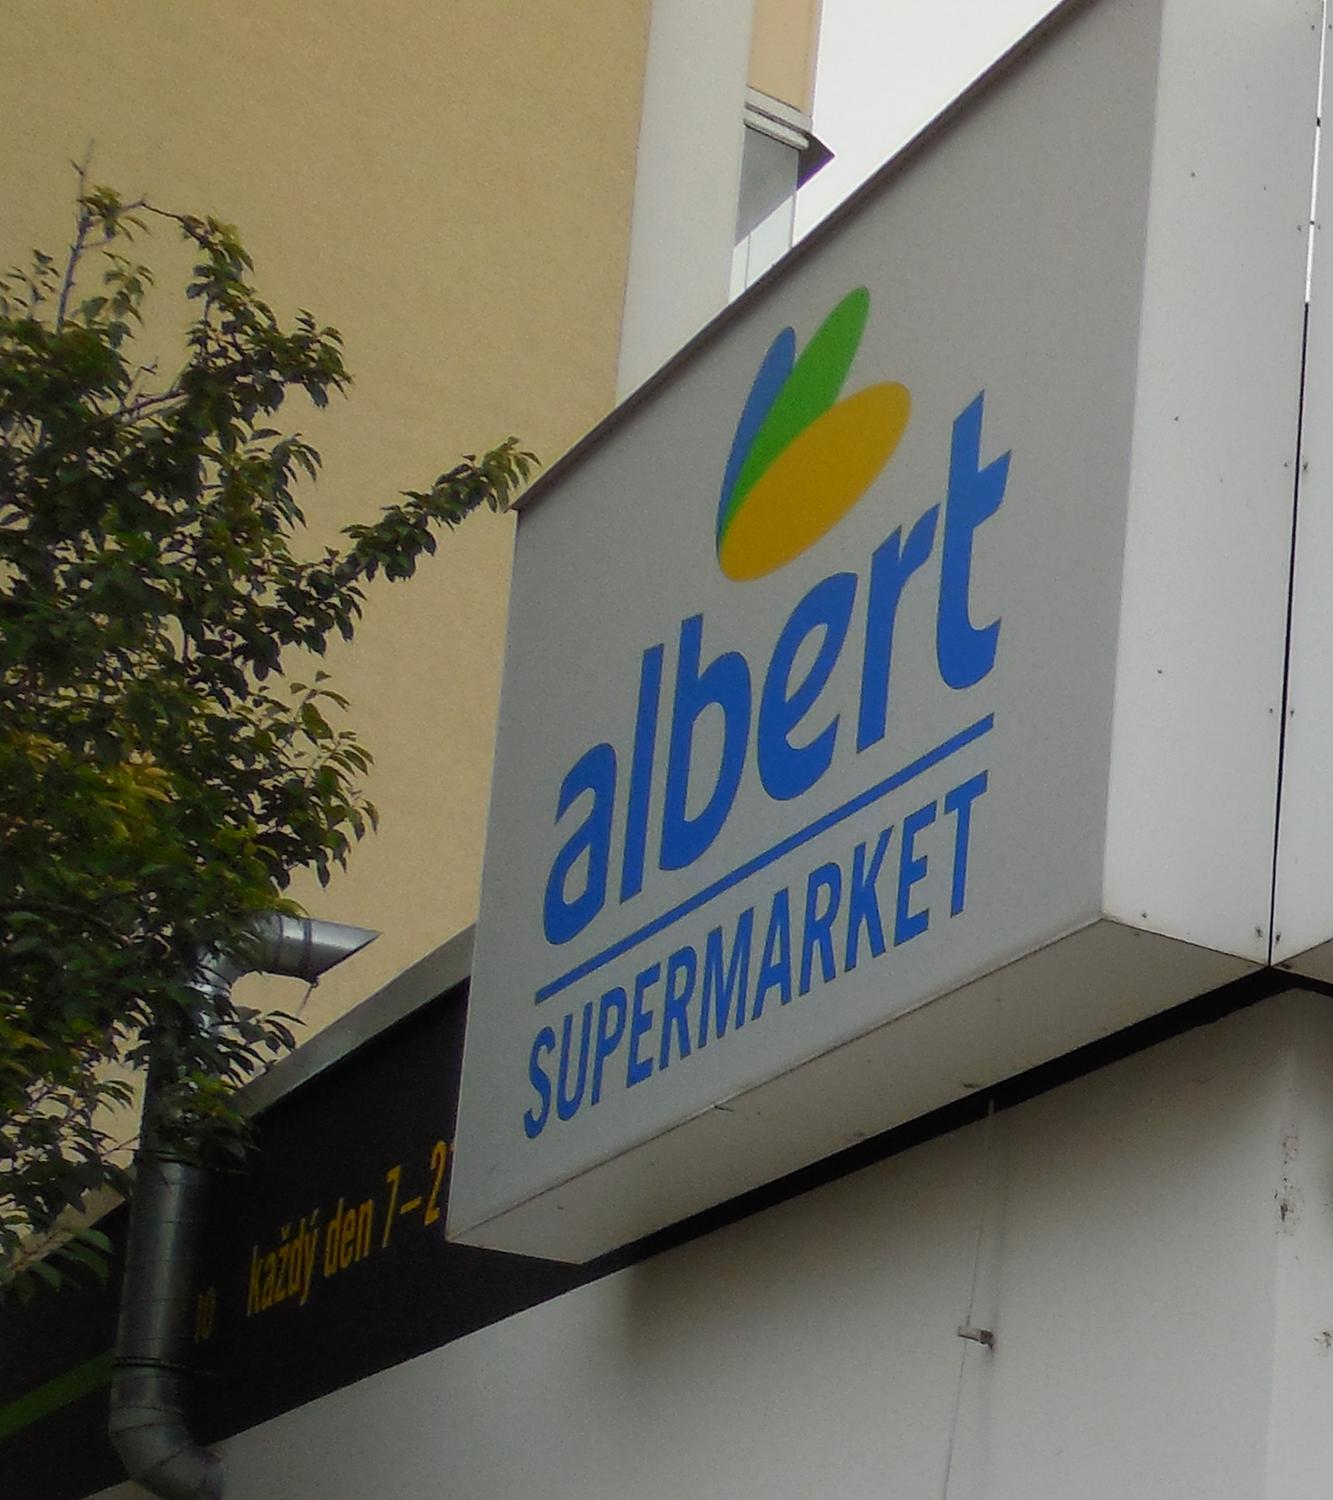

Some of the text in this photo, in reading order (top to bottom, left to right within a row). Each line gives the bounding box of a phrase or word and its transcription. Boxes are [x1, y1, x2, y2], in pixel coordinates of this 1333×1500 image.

[542, 389, 1012, 945] albert
[523, 770, 988, 1139] SUPERMARKET
[247, 1208, 319, 1317] každý
[323, 1197, 374, 1278] den
